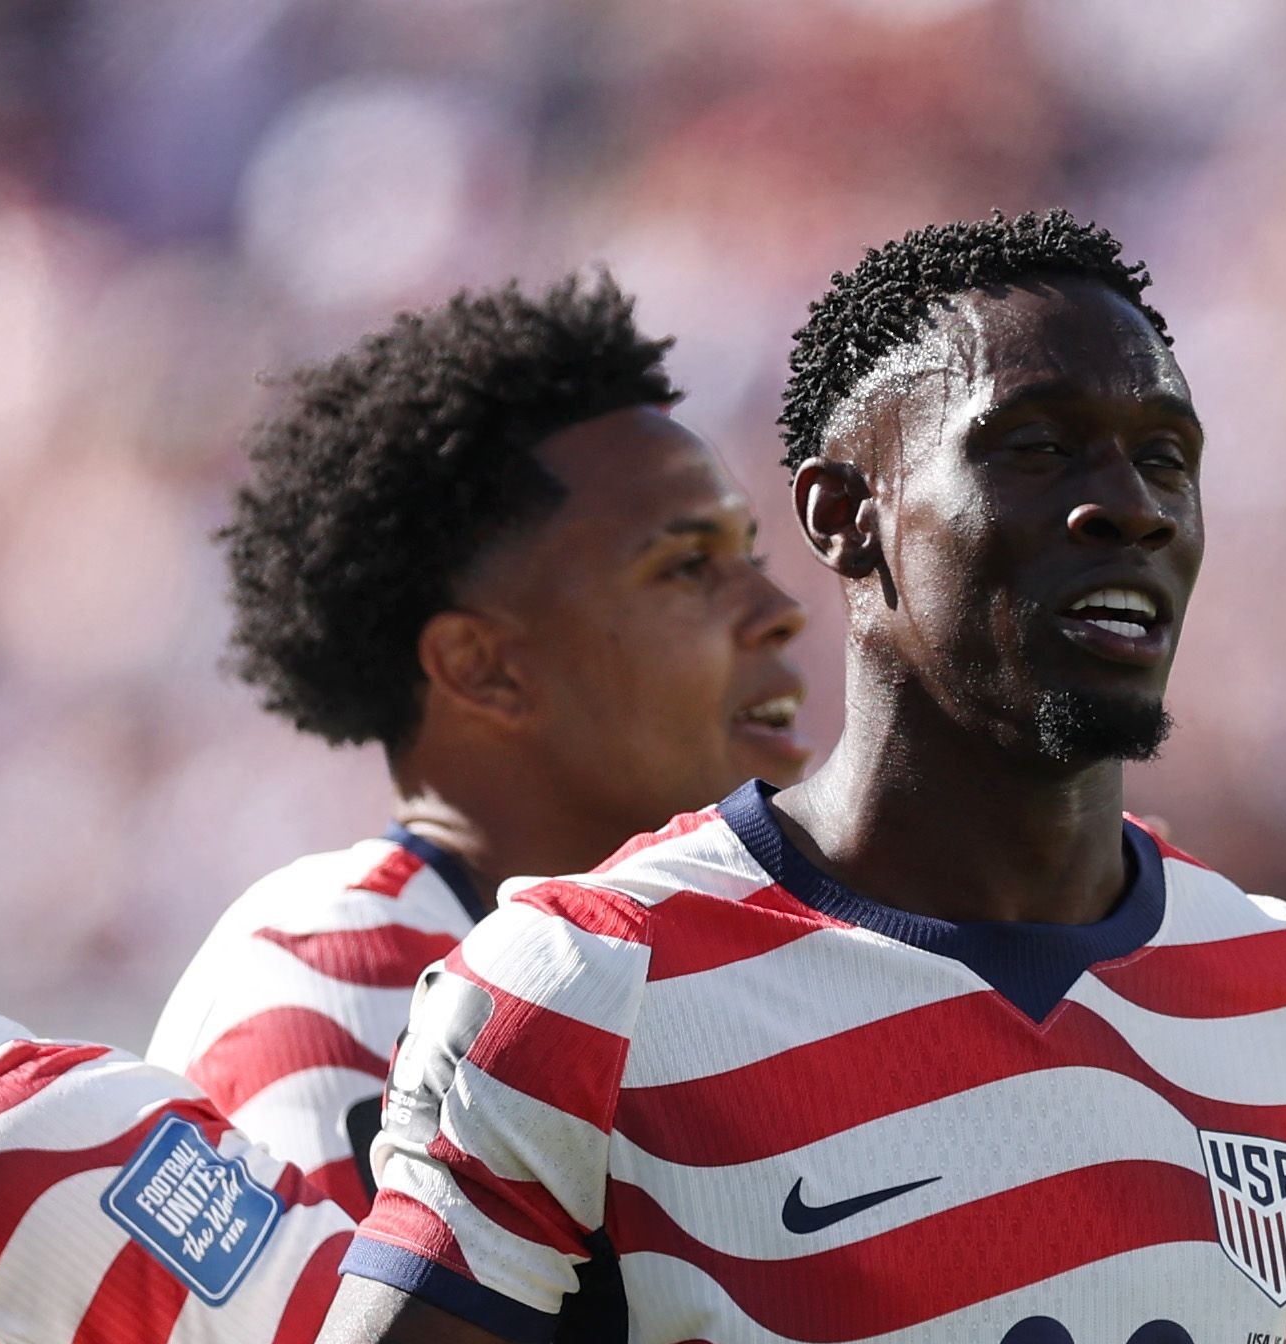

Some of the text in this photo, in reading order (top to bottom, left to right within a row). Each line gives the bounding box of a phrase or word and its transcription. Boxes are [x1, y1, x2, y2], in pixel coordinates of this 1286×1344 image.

[136, 1139, 199, 1216] FOOTBALL
[155, 1157, 226, 1238] UNITES
[182, 1168, 243, 1263] the World
[220, 1217, 248, 1253] FIFA
